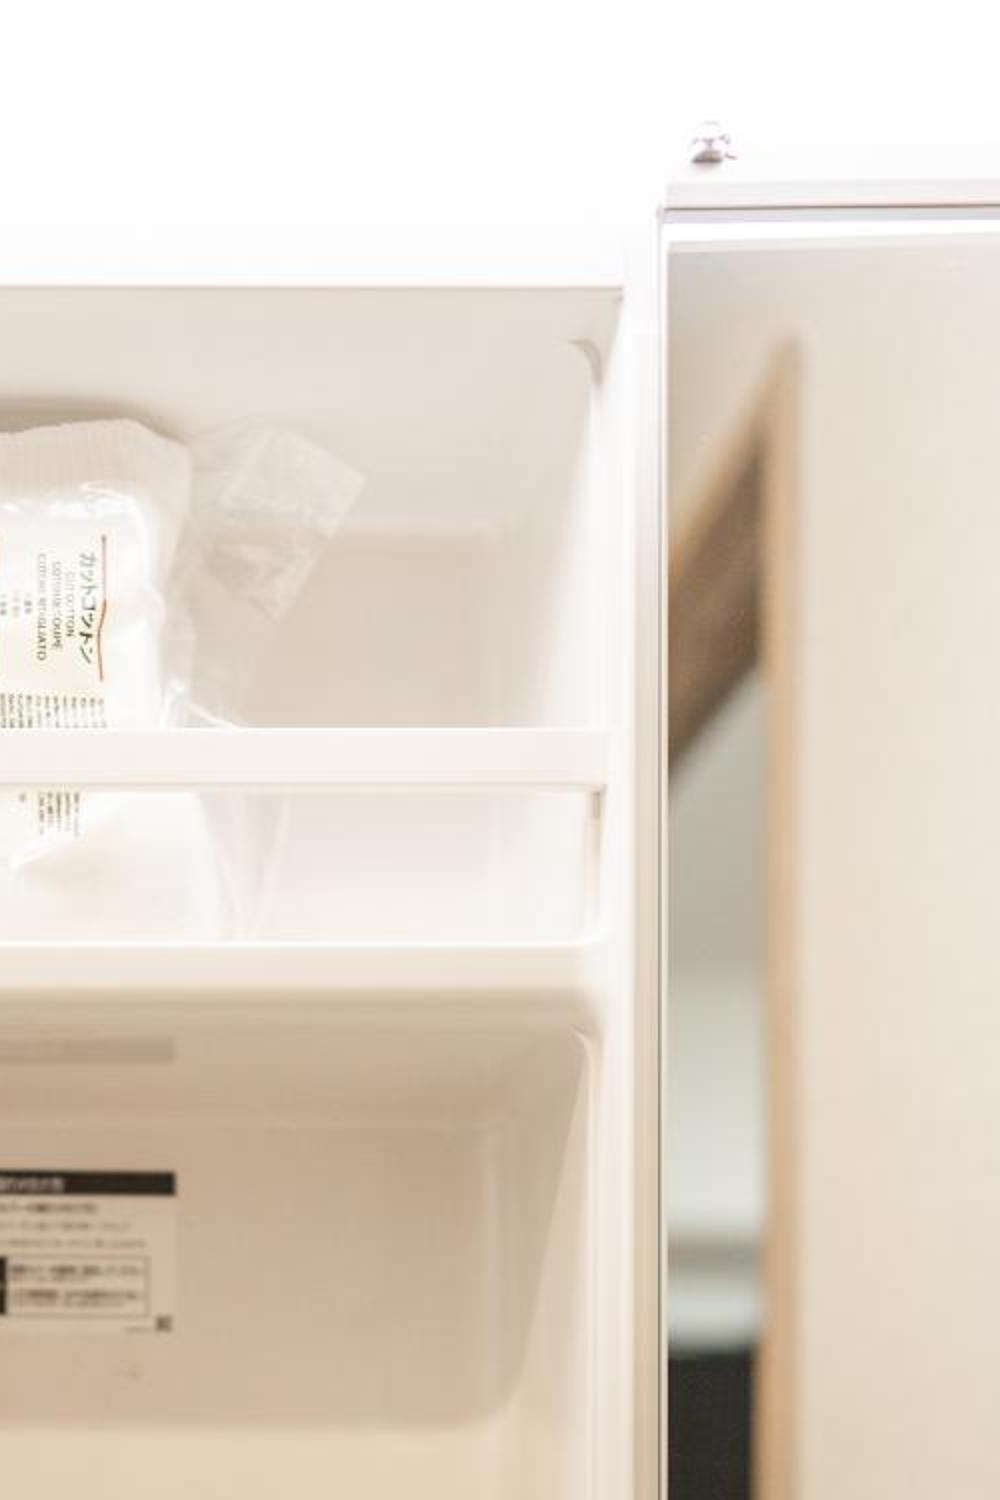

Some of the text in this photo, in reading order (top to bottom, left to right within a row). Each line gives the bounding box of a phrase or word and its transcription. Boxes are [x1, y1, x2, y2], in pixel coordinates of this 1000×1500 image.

[79, 551, 97, 665] カットコットン
